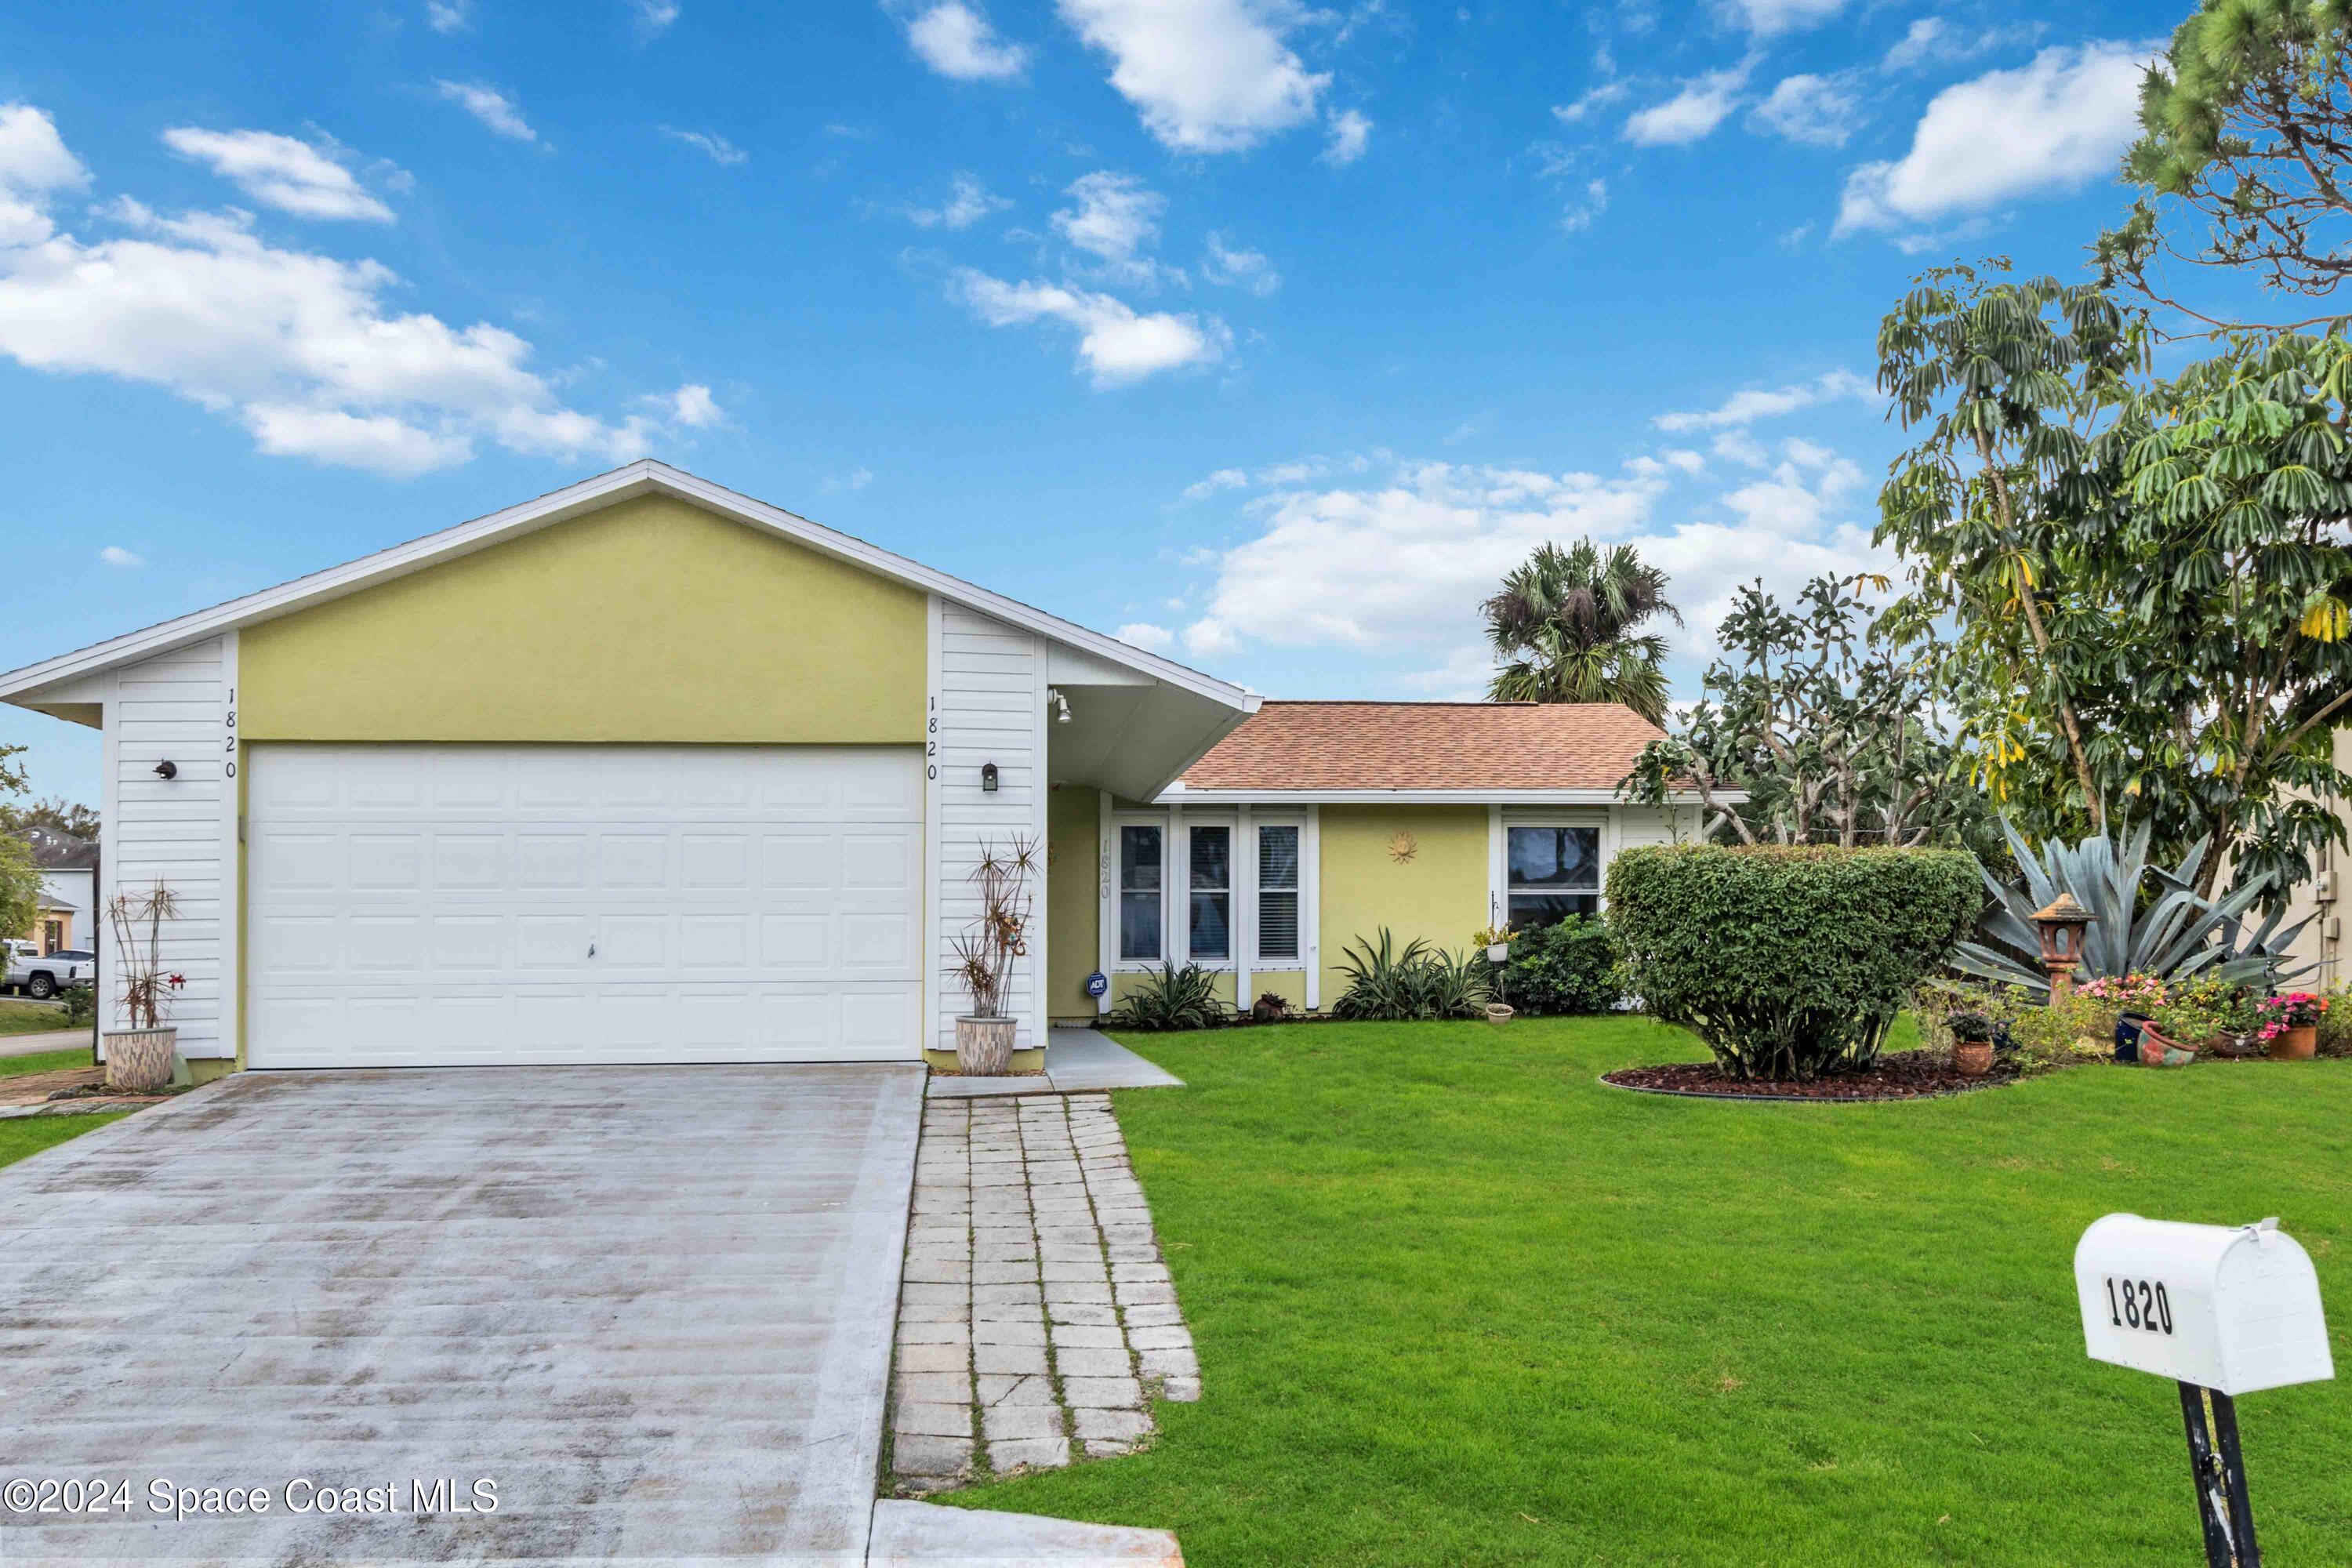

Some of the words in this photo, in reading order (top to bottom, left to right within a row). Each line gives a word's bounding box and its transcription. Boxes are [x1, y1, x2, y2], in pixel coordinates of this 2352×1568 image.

[226, 688, 237, 779] 1820
[927, 696, 938, 780] 1820
[1101, 839, 1110, 899] 1820
[1091, 979, 1104, 989] ADT
[2107, 1276, 2172, 1335] 1820
